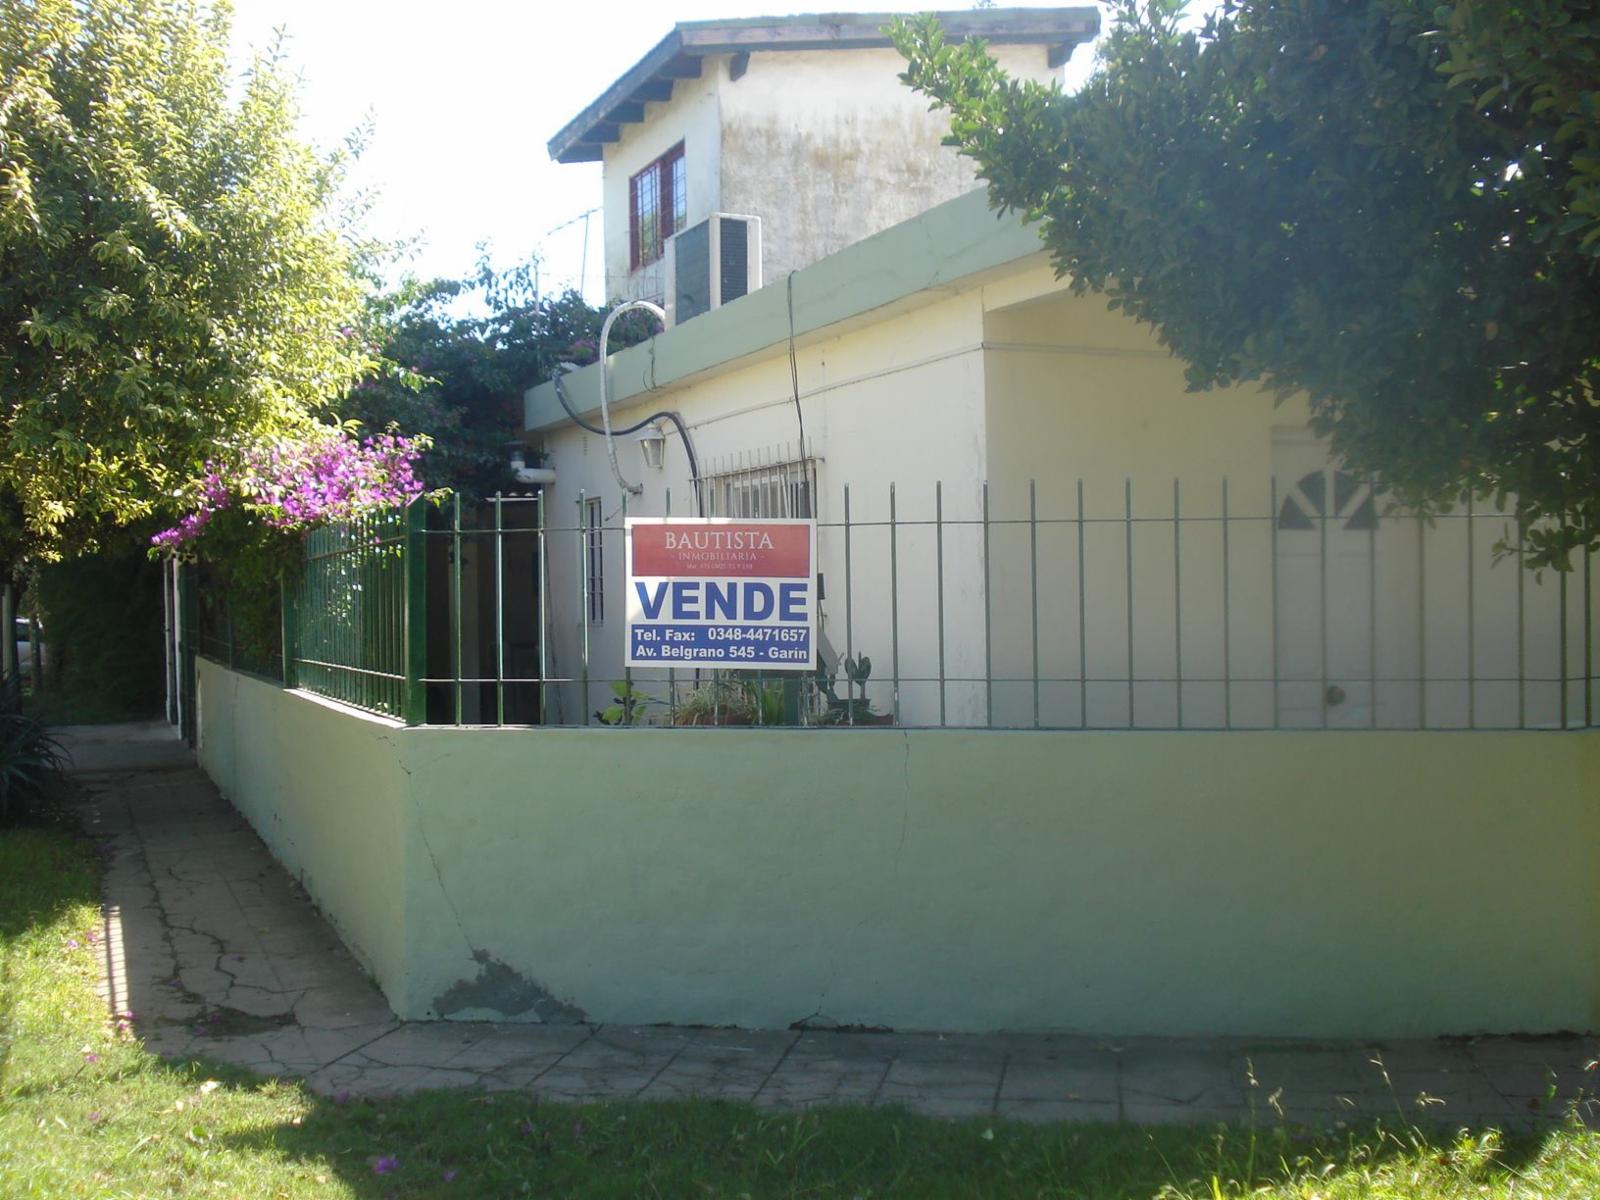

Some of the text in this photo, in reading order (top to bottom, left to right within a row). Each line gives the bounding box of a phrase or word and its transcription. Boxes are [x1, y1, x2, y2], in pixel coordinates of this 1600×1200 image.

[665, 532, 774, 549] BAUTISTA
[678, 552, 757, 561] INMOBILIARIA
[634, 582, 808, 622] VENDE
[635, 627, 807, 642] Tel. Fax: 0348-4471657
[636, 645, 657, 657] Av.
[662, 645, 725, 660] Belgrano
[729, 646, 755, 658] 545
